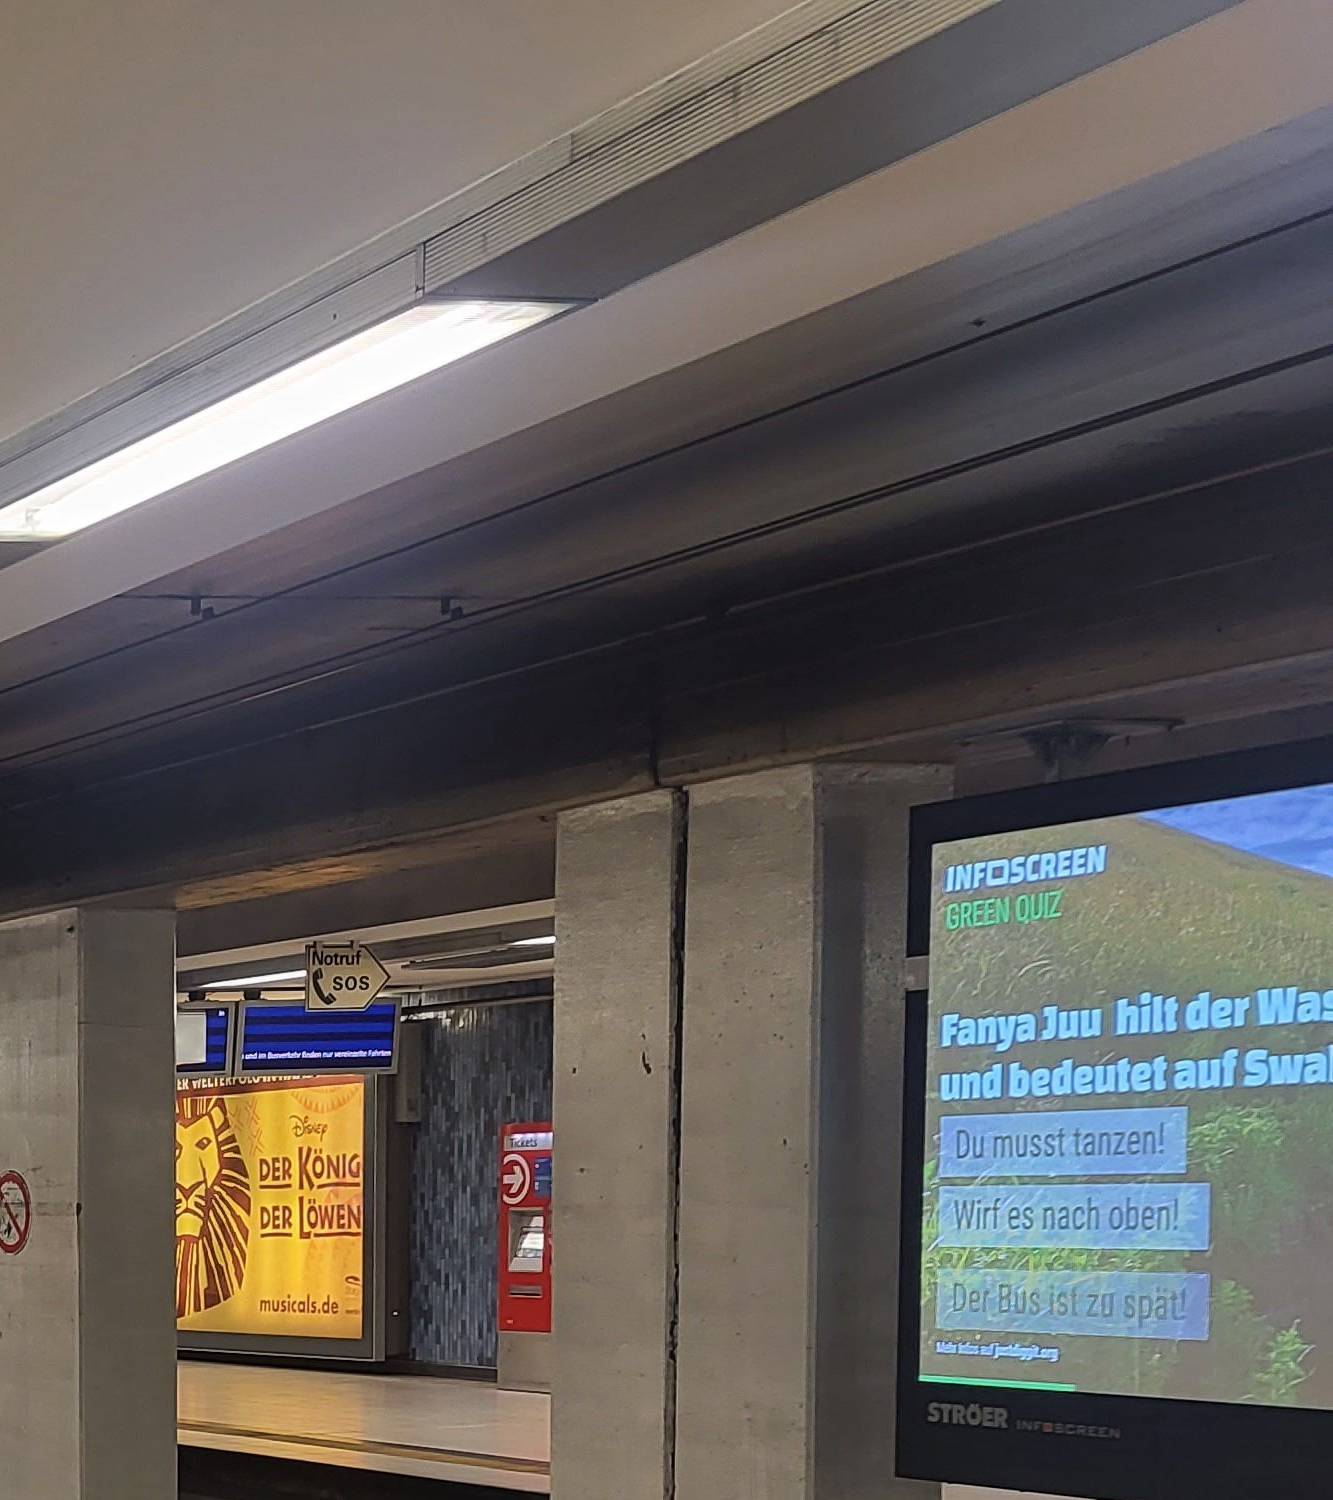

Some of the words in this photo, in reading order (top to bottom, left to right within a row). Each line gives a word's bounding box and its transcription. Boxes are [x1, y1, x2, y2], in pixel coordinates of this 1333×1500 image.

[944, 845, 1107, 893] INFOSCREEN
[945, 897, 1009, 930] GREEN
[1015, 890, 1063, 925] QUIZ
[312, 949, 362, 966] Notruf
[333, 975, 370, 991] SOS
[940, 1012, 1037, 1053] Fanya
[1040, 1006, 1101, 1041] Juu
[1185, 992, 1250, 1031] der
[940, 1063, 1001, 1102] und
[1008, 1055, 1167, 1098] bedeutet
[1173, 1048, 1239, 1091] auf
[1243, 1043, 1333, 1088] Swa
[510, 1136, 538, 1148] Tickets
[956, 1130, 983, 1160] Du
[993, 1127, 1066, 1159] musst
[1073, 1122, 1165, 1156] tanzen!
[259, 1156, 292, 1181] DER
[298, 1145, 361, 1191] KÖNIG
[260, 1205, 292, 1230] DER
[298, 1195, 361, 1239] LÖWEN
[955, 1197, 1001, 1230] Wirf
[1008, 1206, 1033, 1230] es
[1042, 1197, 1100, 1231] nach
[1109, 1197, 1179, 1231] oben!
[259, 1294, 339, 1315] musicals.de
[953, 1282, 990, 1313] Der
[998, 1284, 1041, 1316] Bus
[1049, 1291, 1078, 1317] ist
[1086, 1294, 1114, 1318] zu
[1124, 1287, 1187, 1328] spät!
[927, 1402, 1009, 1429] STRÖER
[1016, 1418, 1121, 1440] INFOSCREEN
